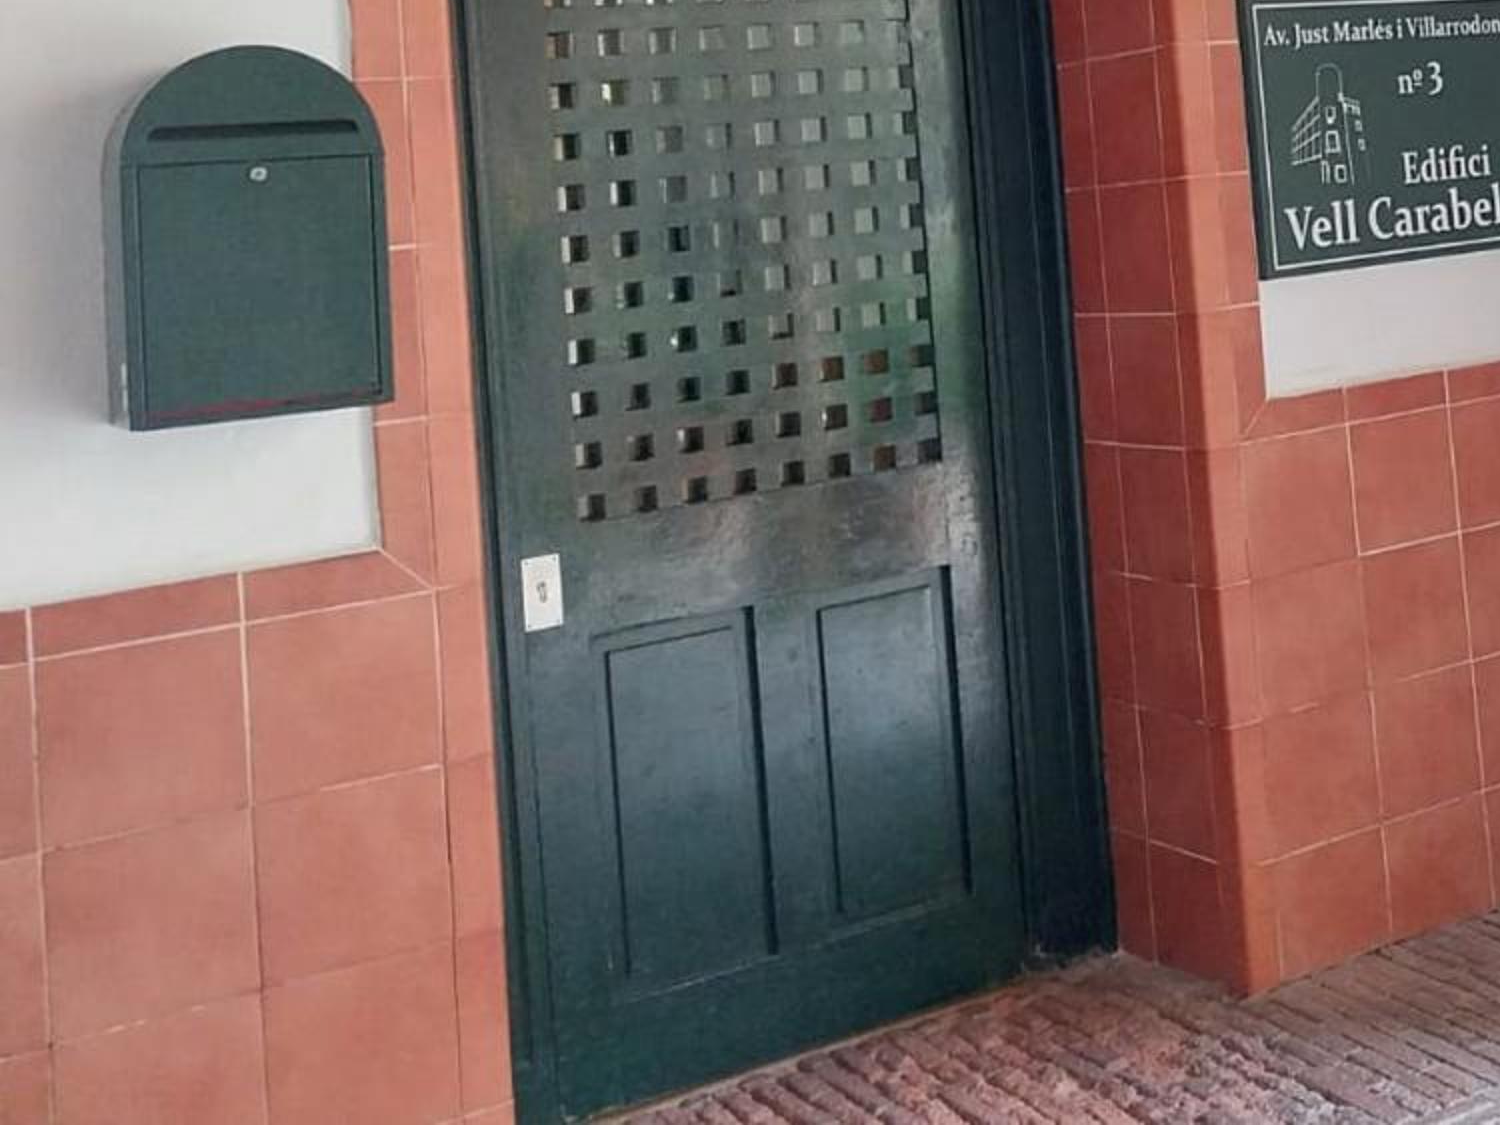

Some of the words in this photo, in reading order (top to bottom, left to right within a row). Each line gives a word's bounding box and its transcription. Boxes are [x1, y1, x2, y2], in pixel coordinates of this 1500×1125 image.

[1263, 24, 1290, 46] Av.
[1294, 23, 1329, 50] Just
[1333, 18, 1394, 43] Marlés
[1402, 144, 1492, 185] Edifici
[1284, 198, 1360, 251] Vell
